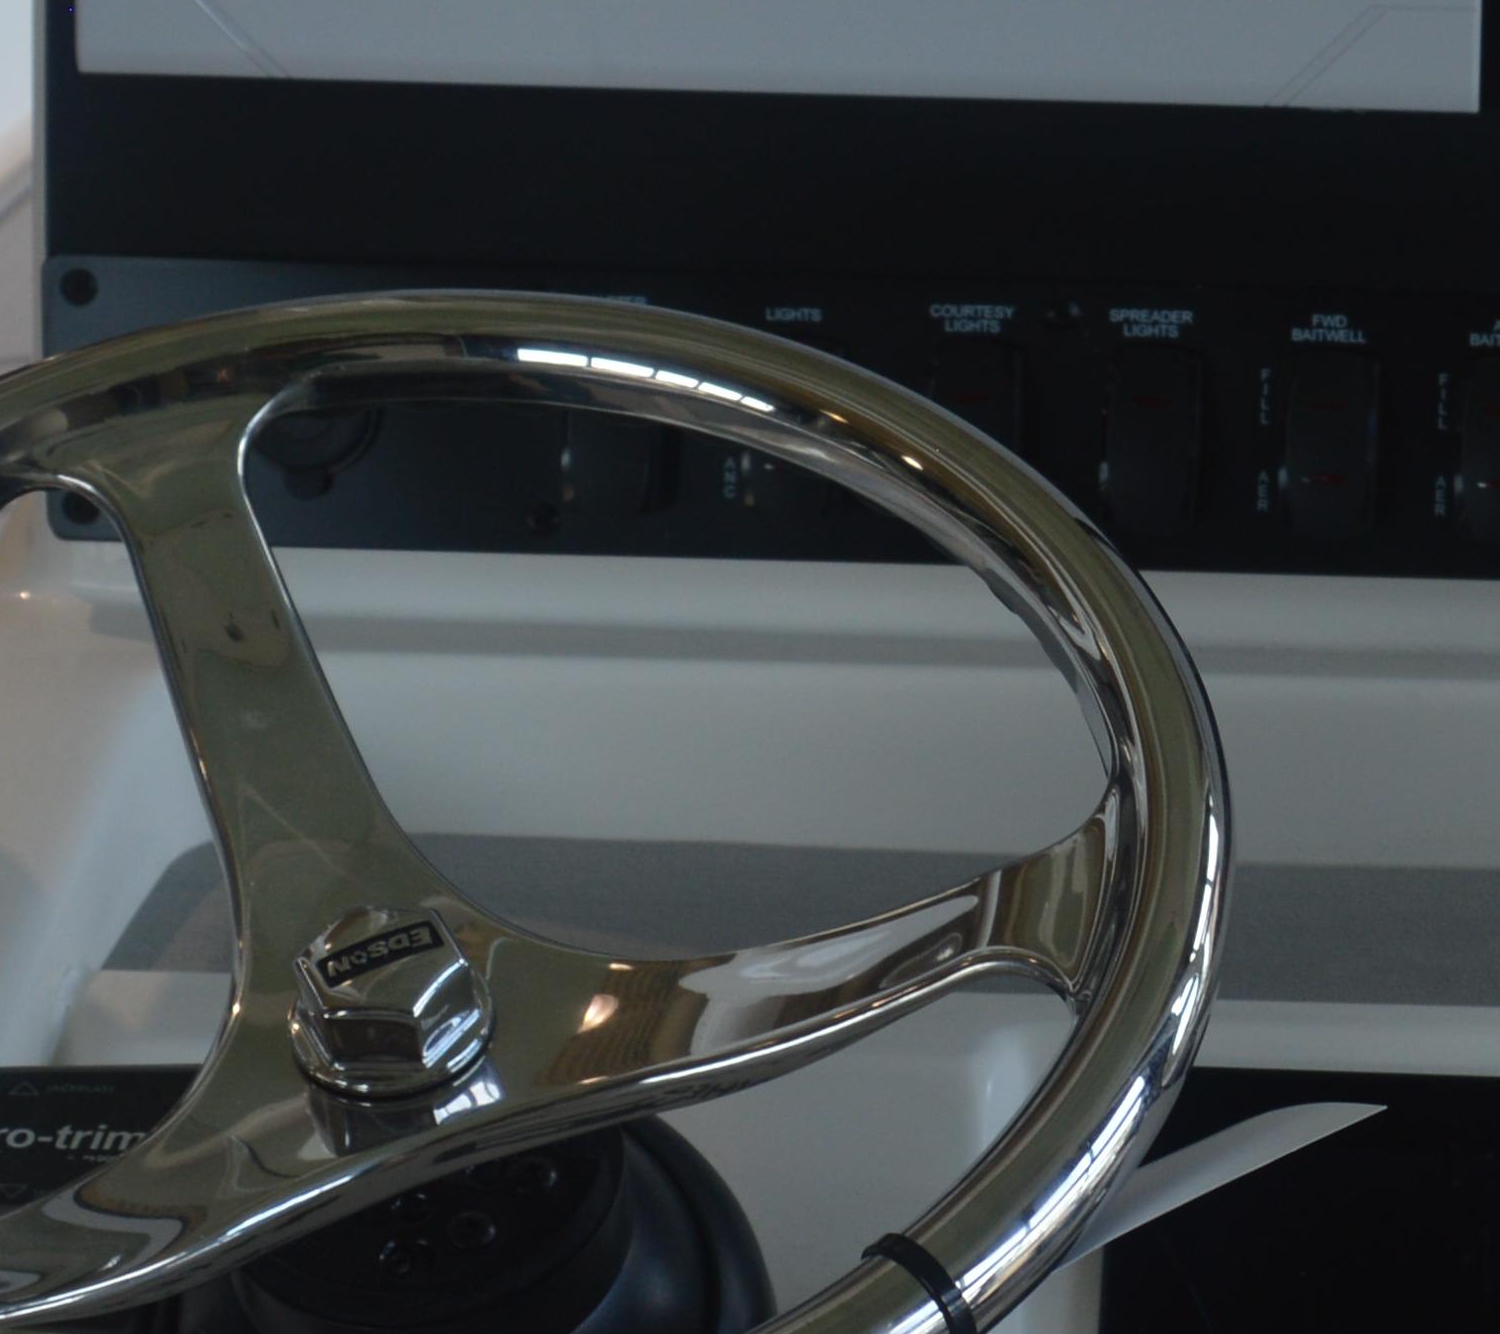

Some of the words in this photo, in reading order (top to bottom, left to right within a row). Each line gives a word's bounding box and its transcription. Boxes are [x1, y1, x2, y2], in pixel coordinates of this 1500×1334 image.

[766, 307, 822, 322] LIGHTS
[929, 303, 1016, 320] COURTESY
[1108, 308, 1194, 324] SPREADER
[944, 318, 1001, 333] LIGHTS
[1311, 313, 1348, 328] FWD
[1122, 322, 1180, 338] LIGHTS
[1291, 327, 1367, 345] BAITWELL
[1259, 367, 1271, 426] FILL
[1437, 372, 1450, 431] FILL
[326, 927, 436, 979] EDSON
